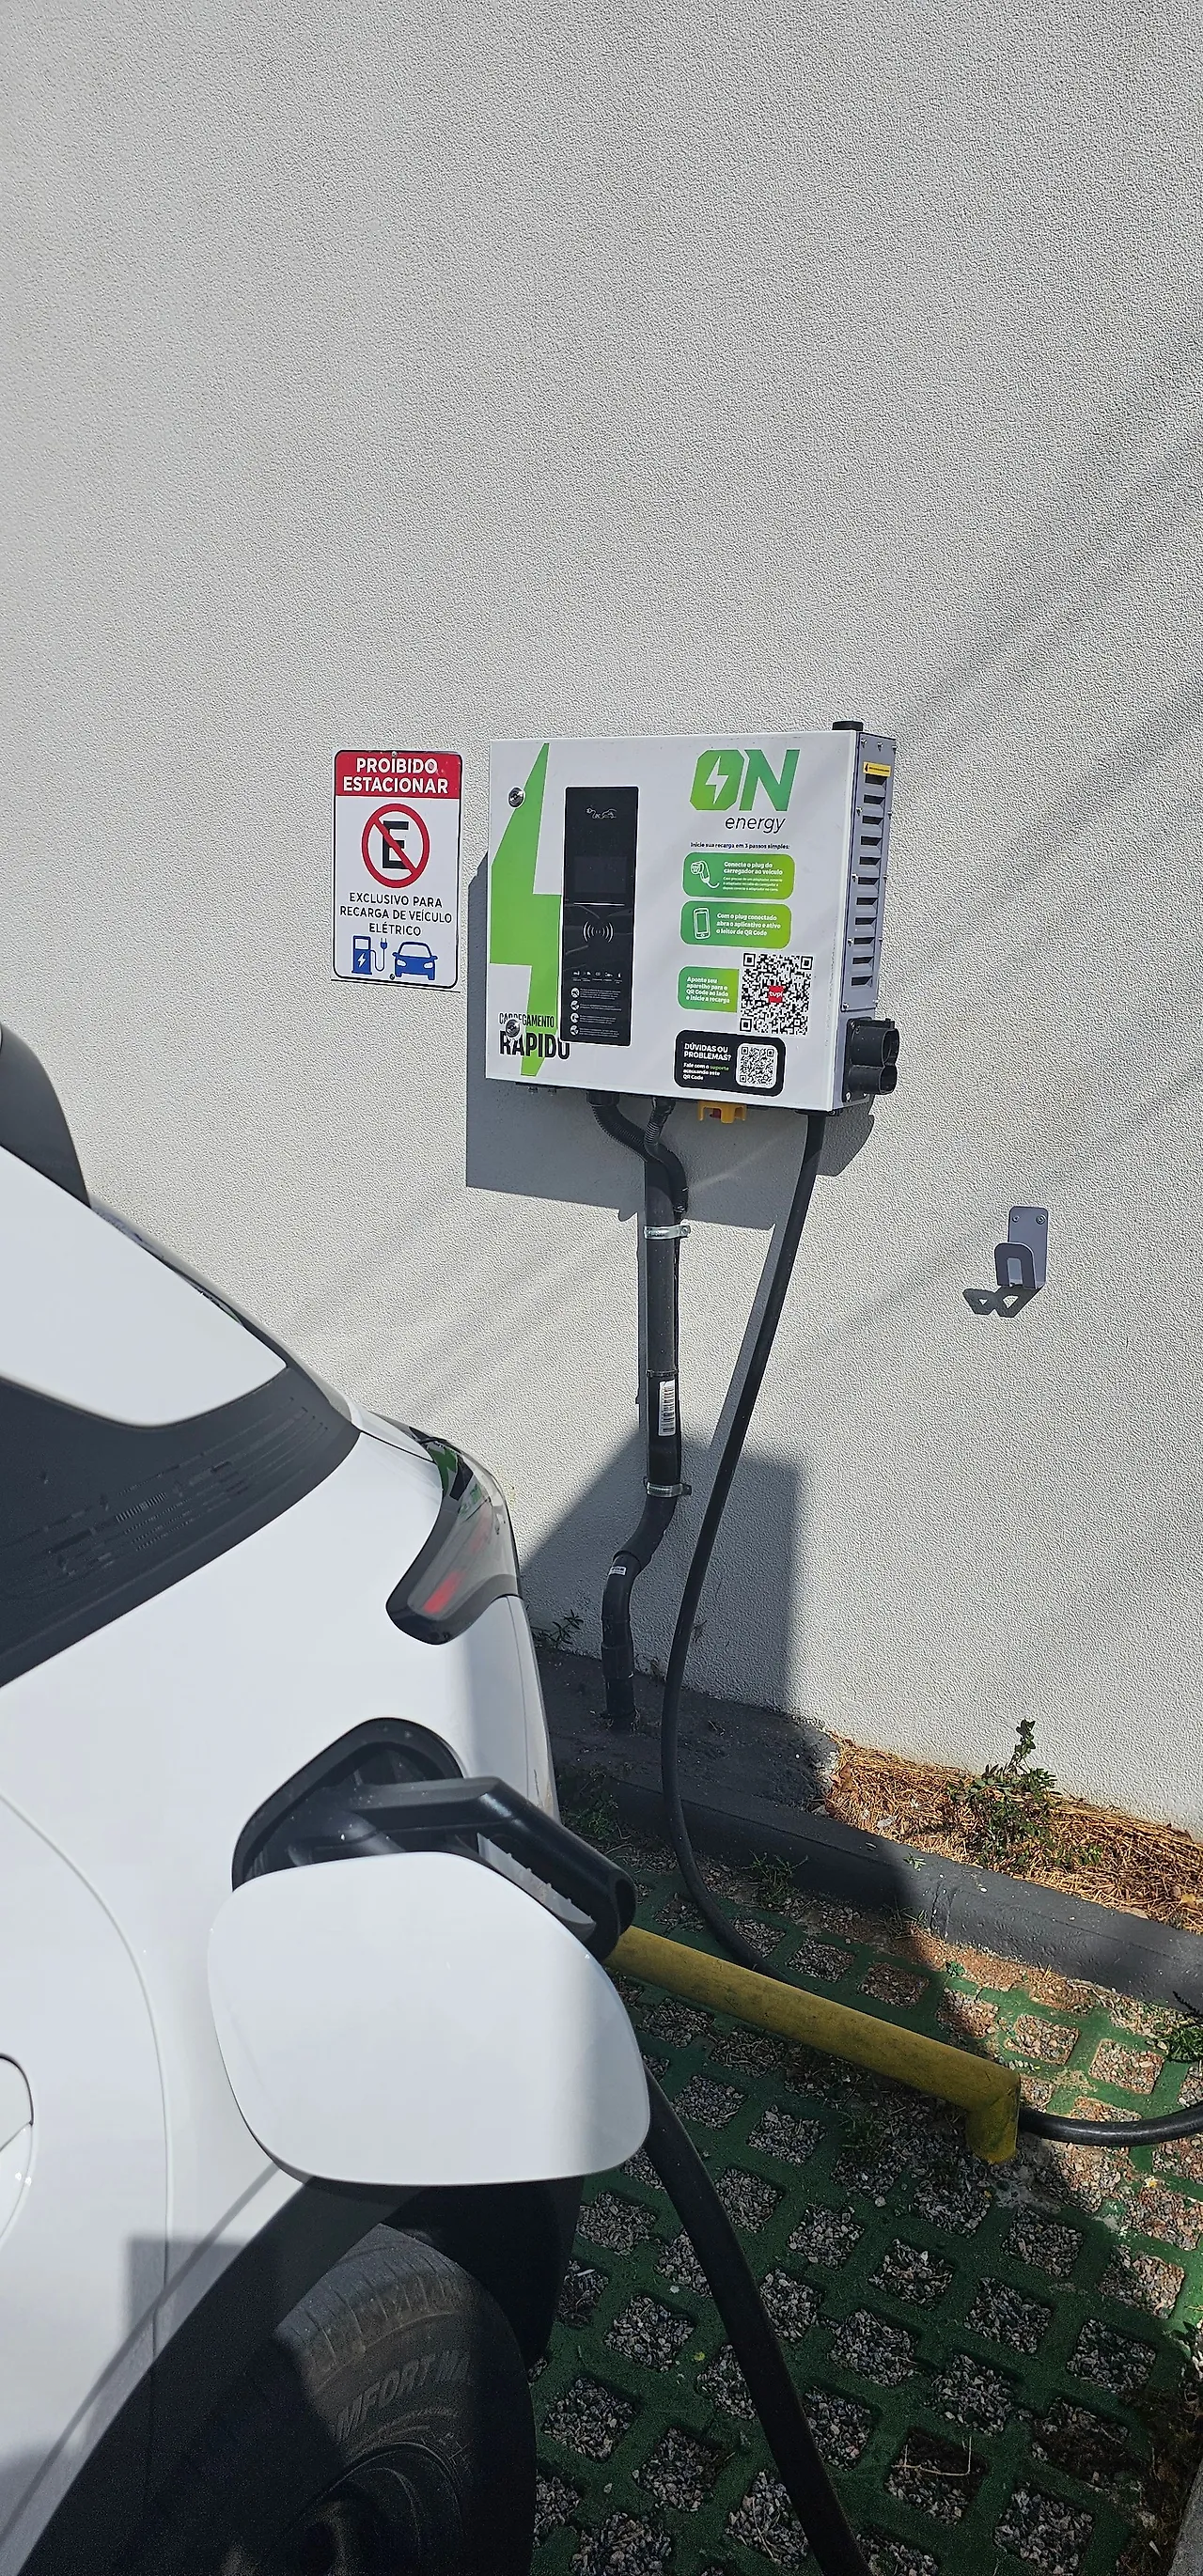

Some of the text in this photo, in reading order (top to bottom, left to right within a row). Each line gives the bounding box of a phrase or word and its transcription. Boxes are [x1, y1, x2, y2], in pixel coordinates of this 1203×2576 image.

[355, 757, 438, 774] PROIBIDO
[342, 775, 449, 794] ESTACIONAR
[689, 748, 801, 812] ON
[724, 816, 787, 835] energy
[382, 820, 411, 869] E
[349, 892, 443, 909] EXCLUSIVO PARA
[339, 905, 453, 924] RECARGA DE VEÍCULO
[368, 921, 422, 937] ELÉTRICO
[709, 996, 730, 1005] recarga
[683, 1050, 732, 1062] PROBLEMAS?
[684, 1041, 728, 1054] DÚVIDAS OU
